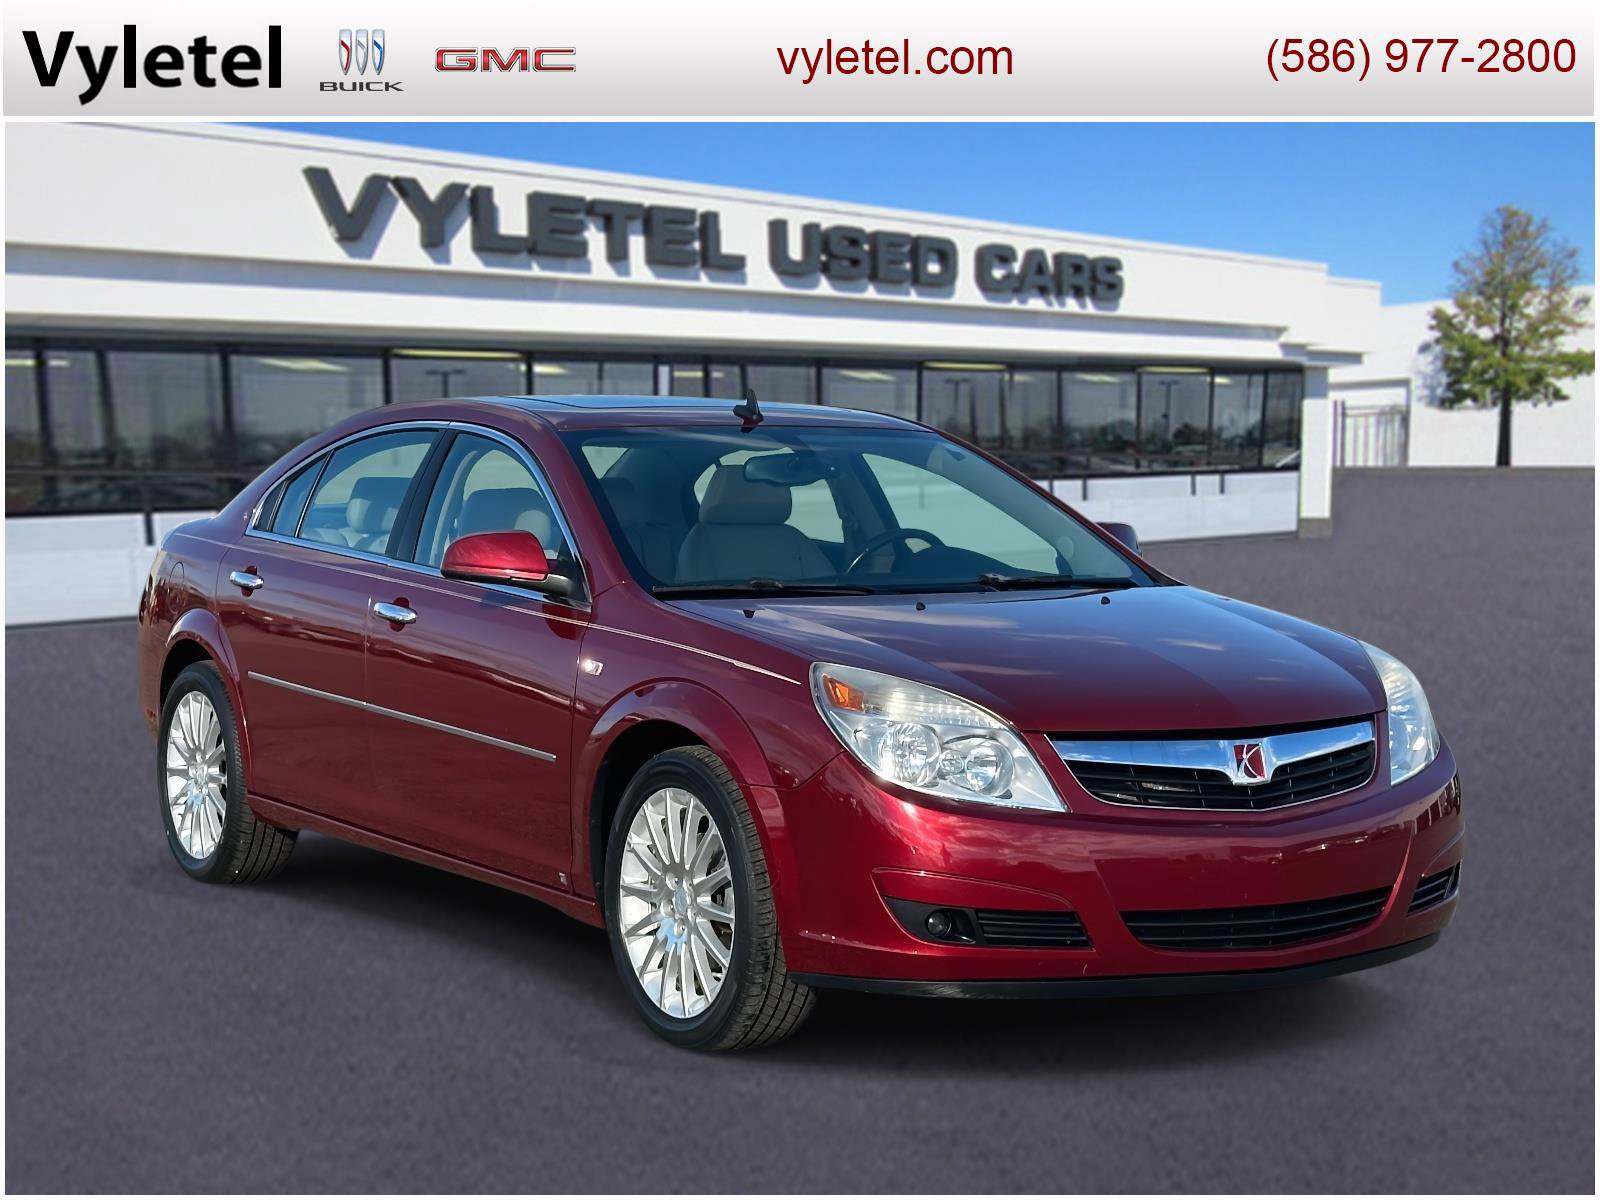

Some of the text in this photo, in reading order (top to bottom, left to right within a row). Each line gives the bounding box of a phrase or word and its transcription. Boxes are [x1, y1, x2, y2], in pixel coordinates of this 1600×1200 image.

[303, 166, 1124, 304] VYLETEL USED CARS
